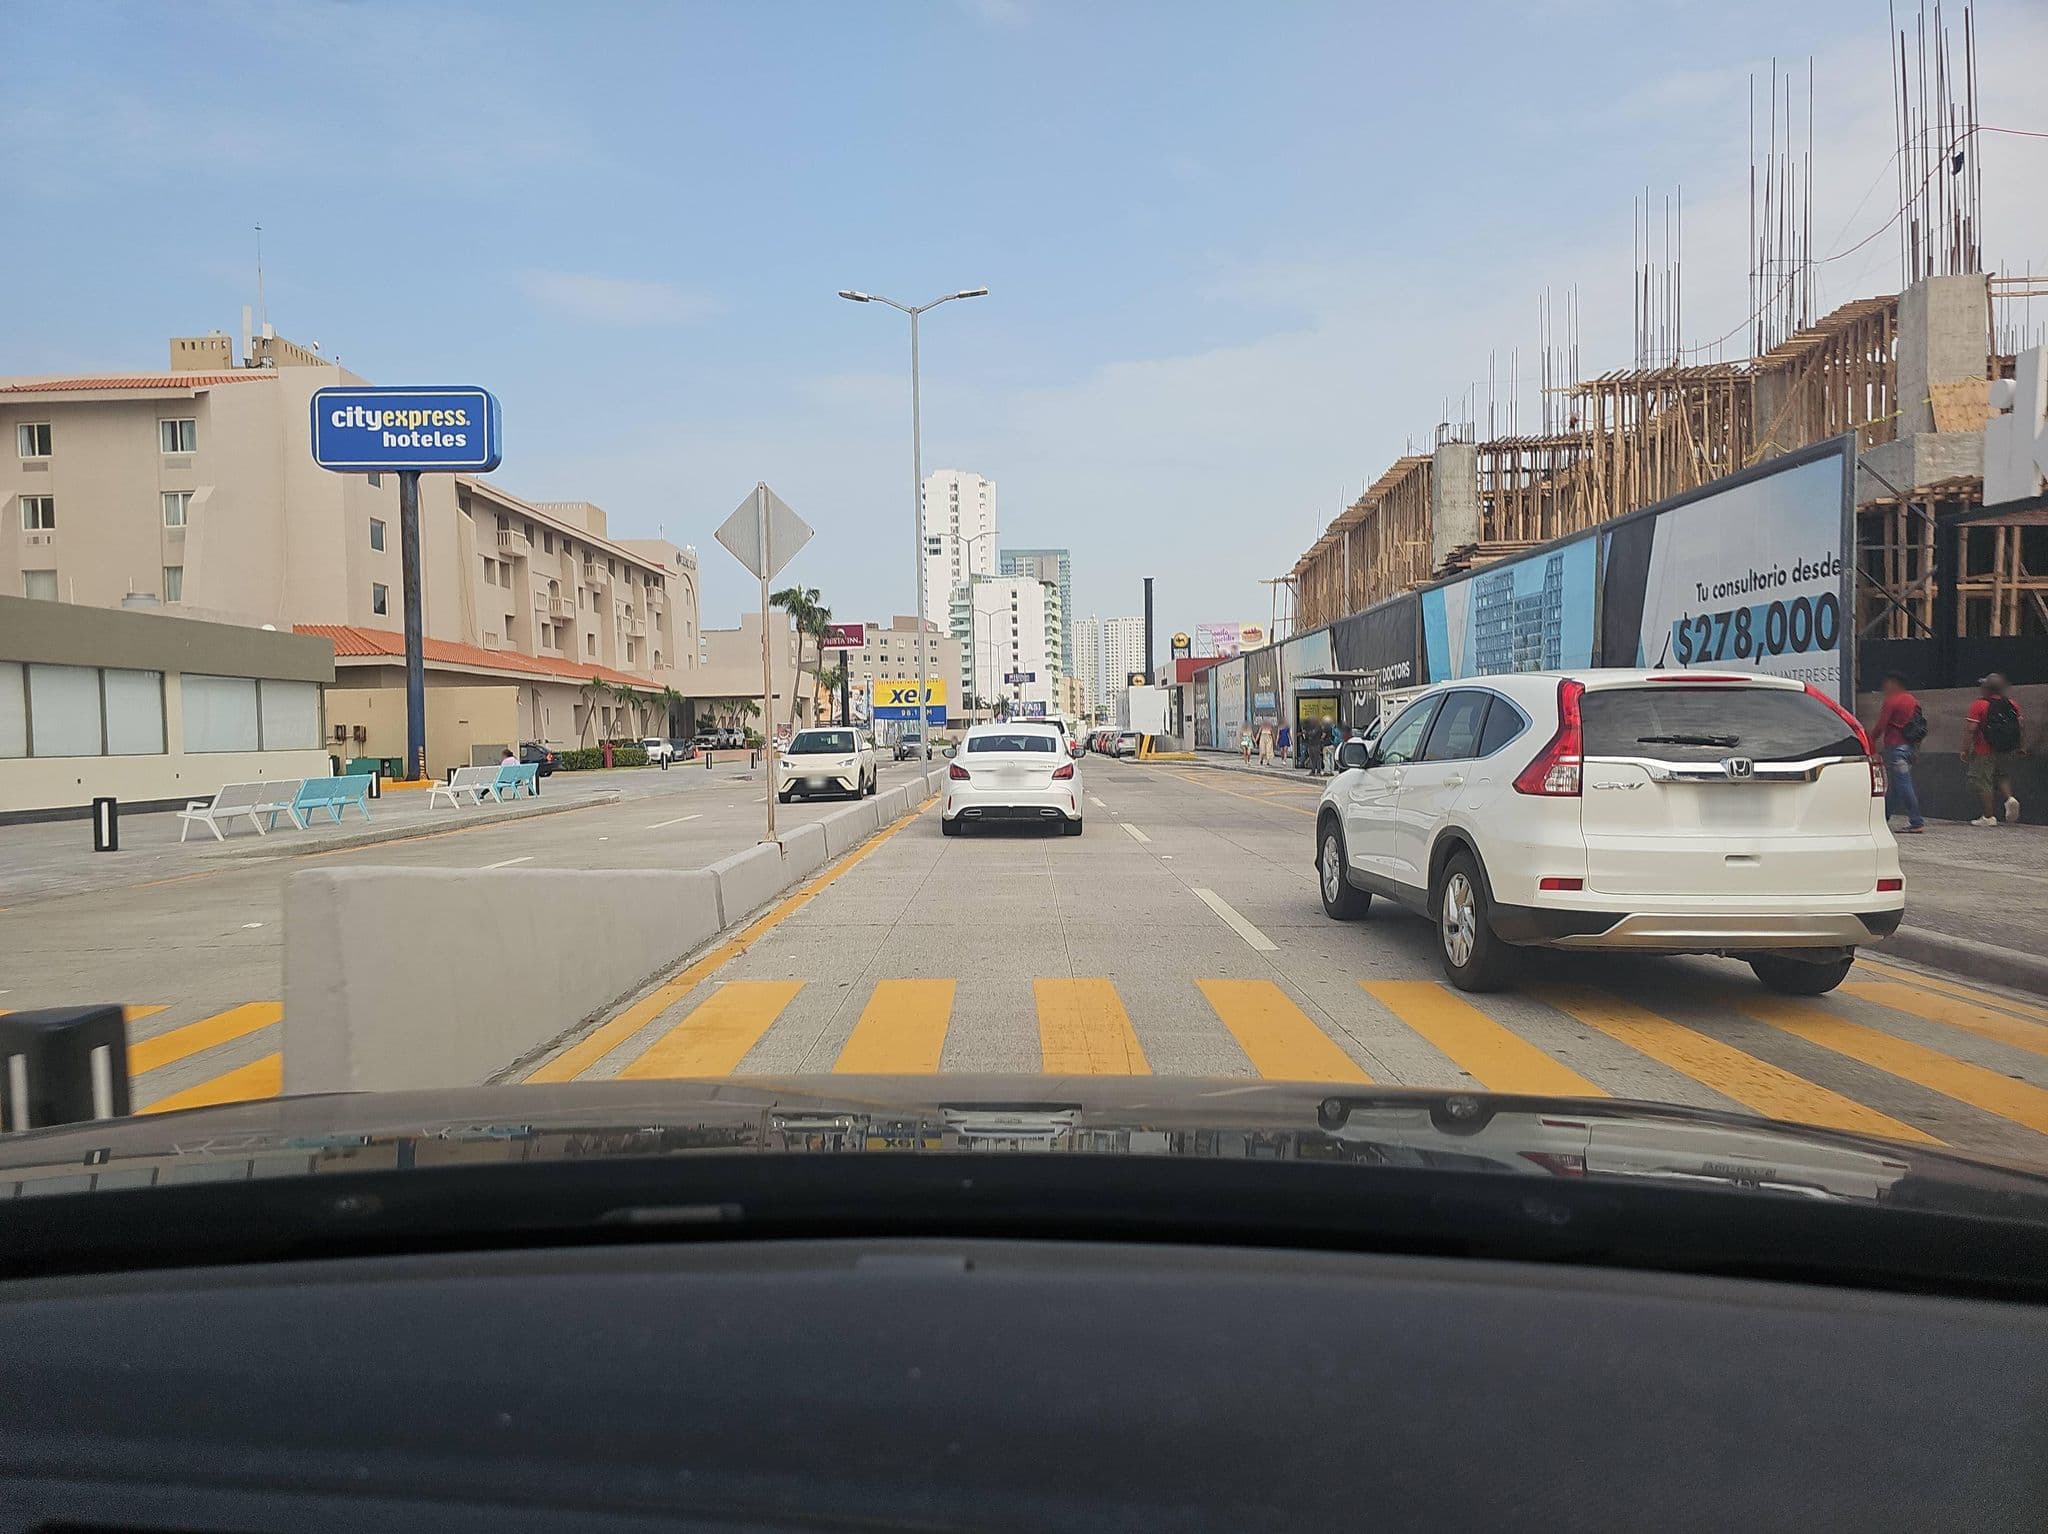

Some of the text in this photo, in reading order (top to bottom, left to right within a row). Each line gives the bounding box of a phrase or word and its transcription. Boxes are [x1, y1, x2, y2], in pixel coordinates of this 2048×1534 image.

[383, 431, 467, 448] hoteles
[1696, 551, 1840, 603] Tu consultorio desde
[1679, 591, 1840, 669] $278,000
[1382, 660, 1410, 683] DOCTORS
